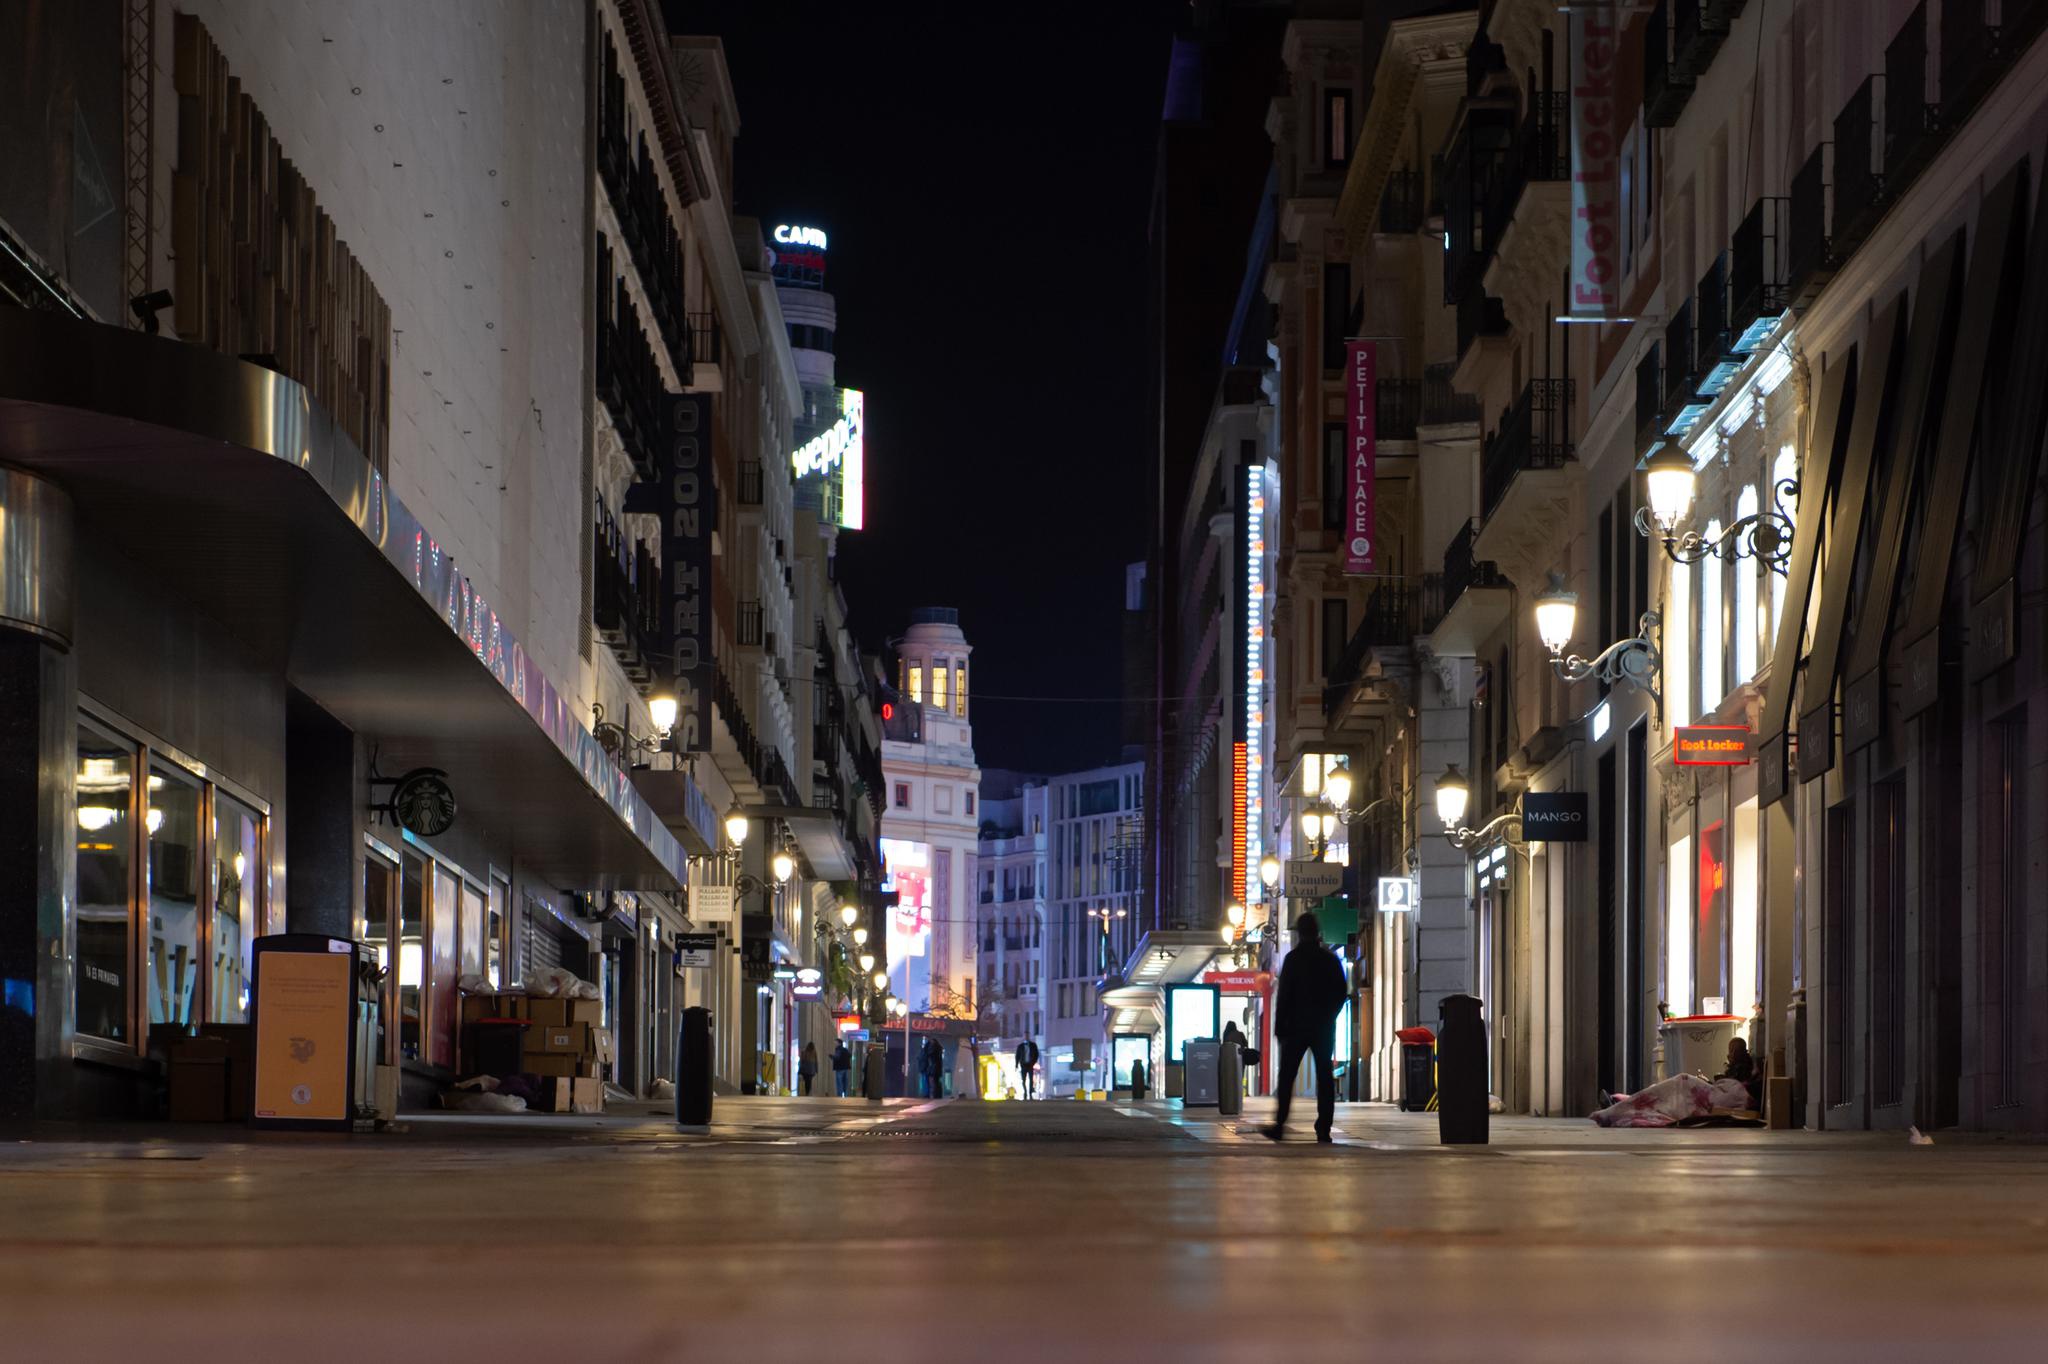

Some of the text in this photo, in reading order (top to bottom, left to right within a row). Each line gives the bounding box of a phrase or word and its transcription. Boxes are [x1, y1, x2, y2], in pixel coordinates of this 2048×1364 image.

[1575, 18, 1614, 306] Foot Locker
[1354, 351, 1368, 533] PETIT PALACE
[672, 399, 700, 753] SPORT 2000
[1680, 739, 1745, 751] Foot Locker
[1528, 811, 1582, 823] MANGO
[1291, 874, 1339, 885] Danubio
[1291, 885, 1318, 896] Azul
